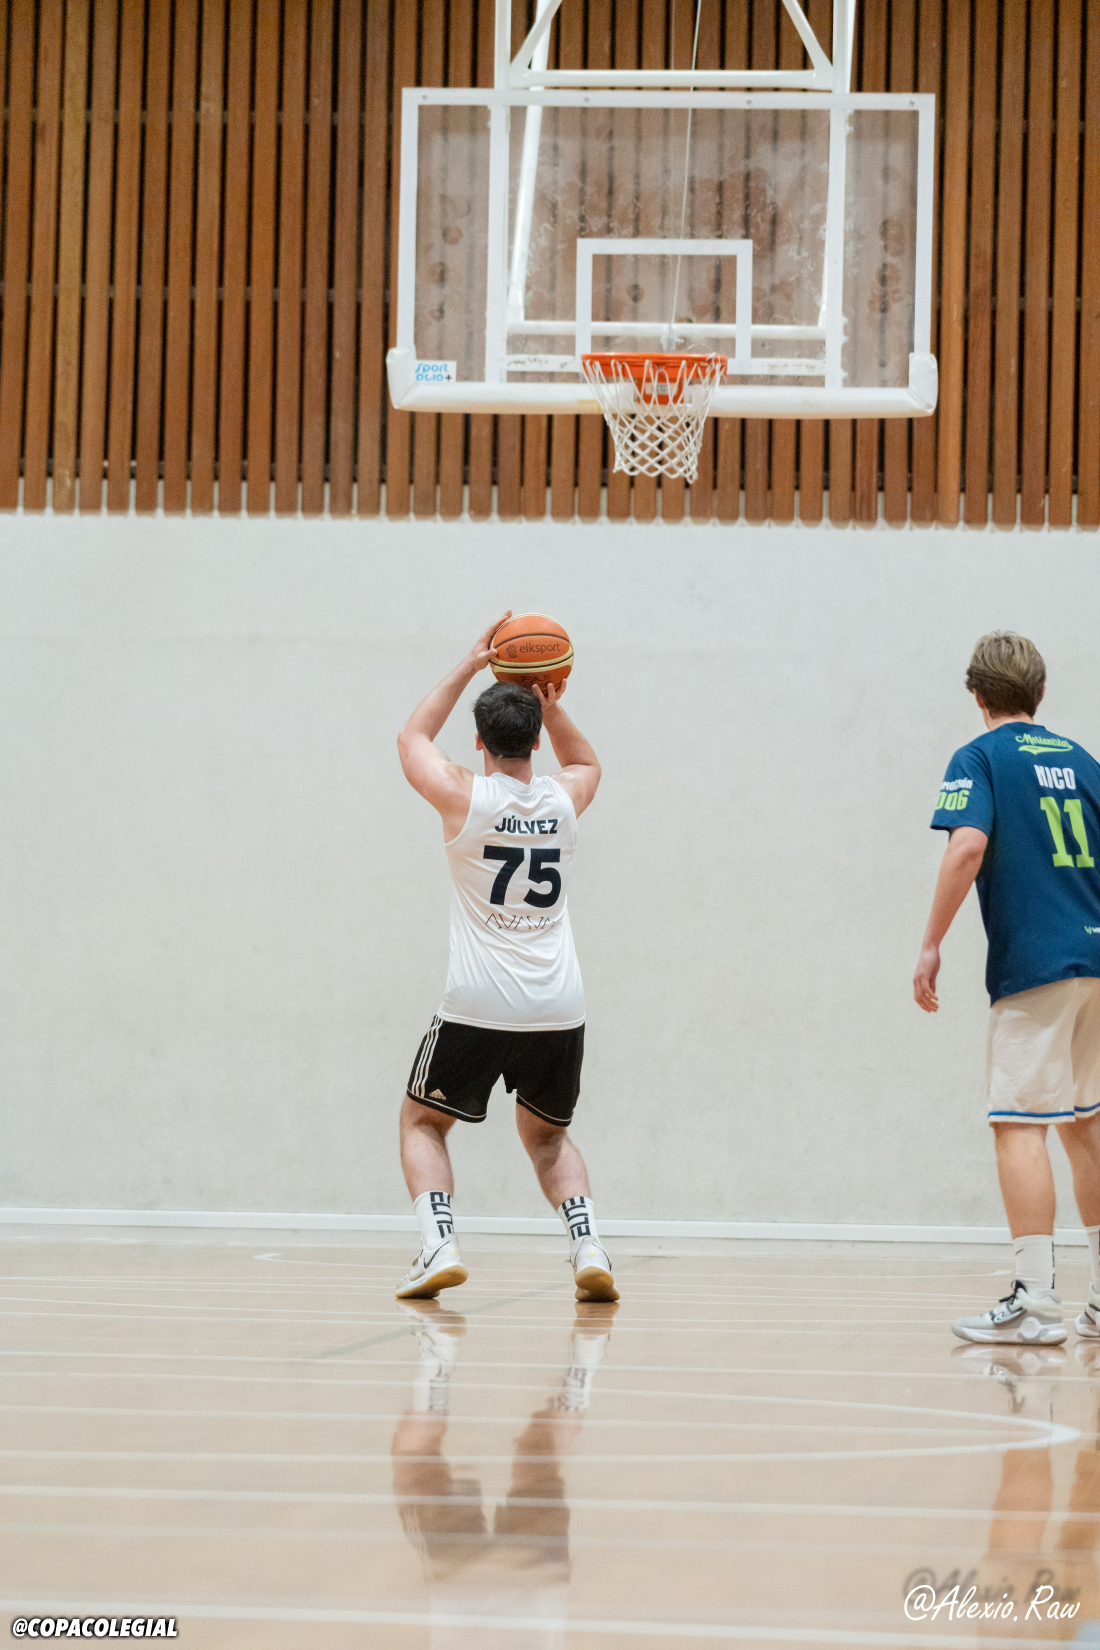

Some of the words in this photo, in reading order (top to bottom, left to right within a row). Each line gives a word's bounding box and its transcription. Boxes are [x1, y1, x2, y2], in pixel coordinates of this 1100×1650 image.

[415, 363, 448, 373] sport
[519, 642, 561, 654] elksport
[1034, 764, 1076, 790] NICO
[494, 815, 558, 834] JÚLVEZ
[1039, 796, 1095, 868] 11
[482, 844, 562, 909] 75
